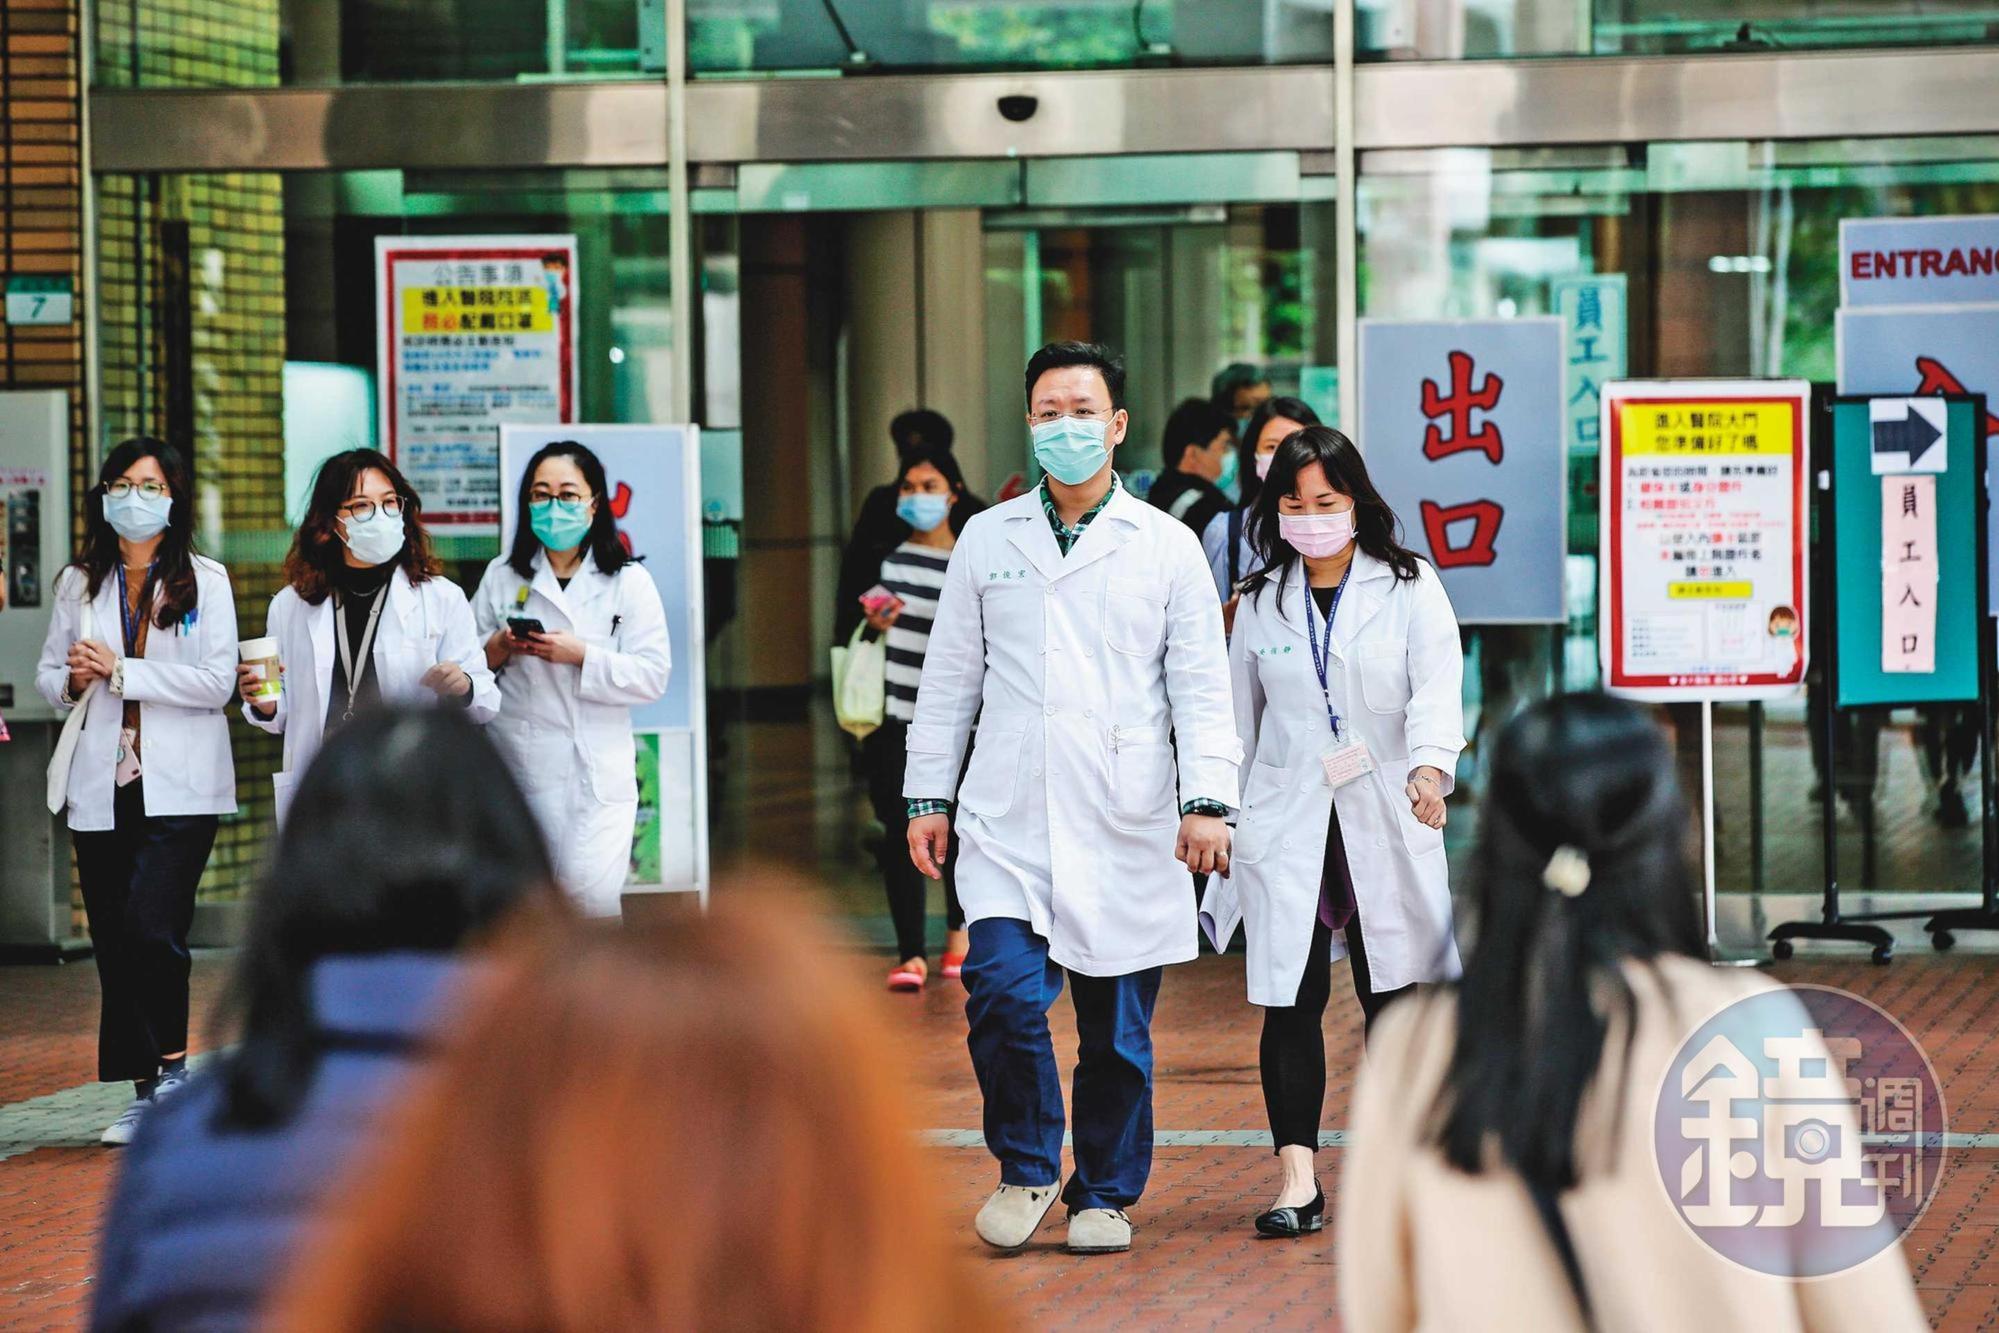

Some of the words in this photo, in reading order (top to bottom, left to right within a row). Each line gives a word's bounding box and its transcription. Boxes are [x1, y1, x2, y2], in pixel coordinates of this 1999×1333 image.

[433, 264, 523, 285] 公告事項
[31, 295, 48, 319] 7
[1655, 412, 1758, 429] 進入醫院大門
[1655, 434, 1758, 451] 您準備好了嗎
[1420, 350, 1504, 570] 出口
[1900, 484, 1921, 654] 員工入口
